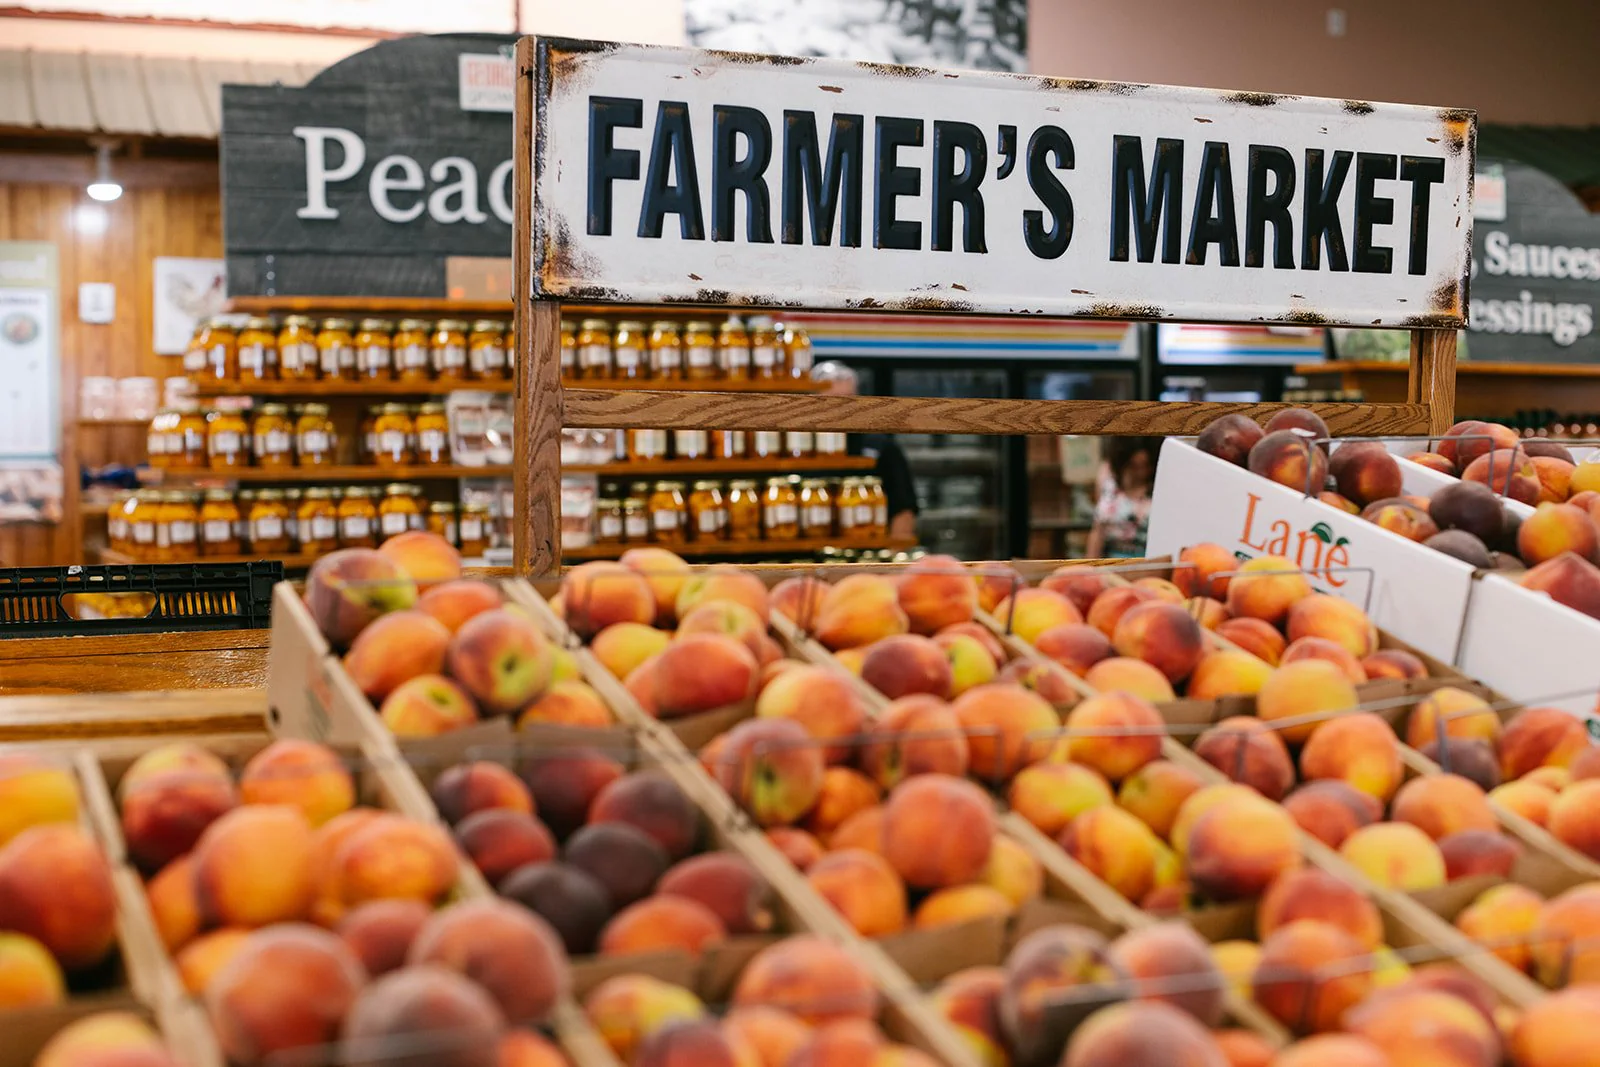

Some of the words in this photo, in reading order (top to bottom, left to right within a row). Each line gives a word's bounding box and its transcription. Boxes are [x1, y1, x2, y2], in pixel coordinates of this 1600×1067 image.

[587, 95, 1076, 260] FARMER'S
[1109, 134, 1446, 276] MARKET
[1238, 492, 1350, 588] Lane
